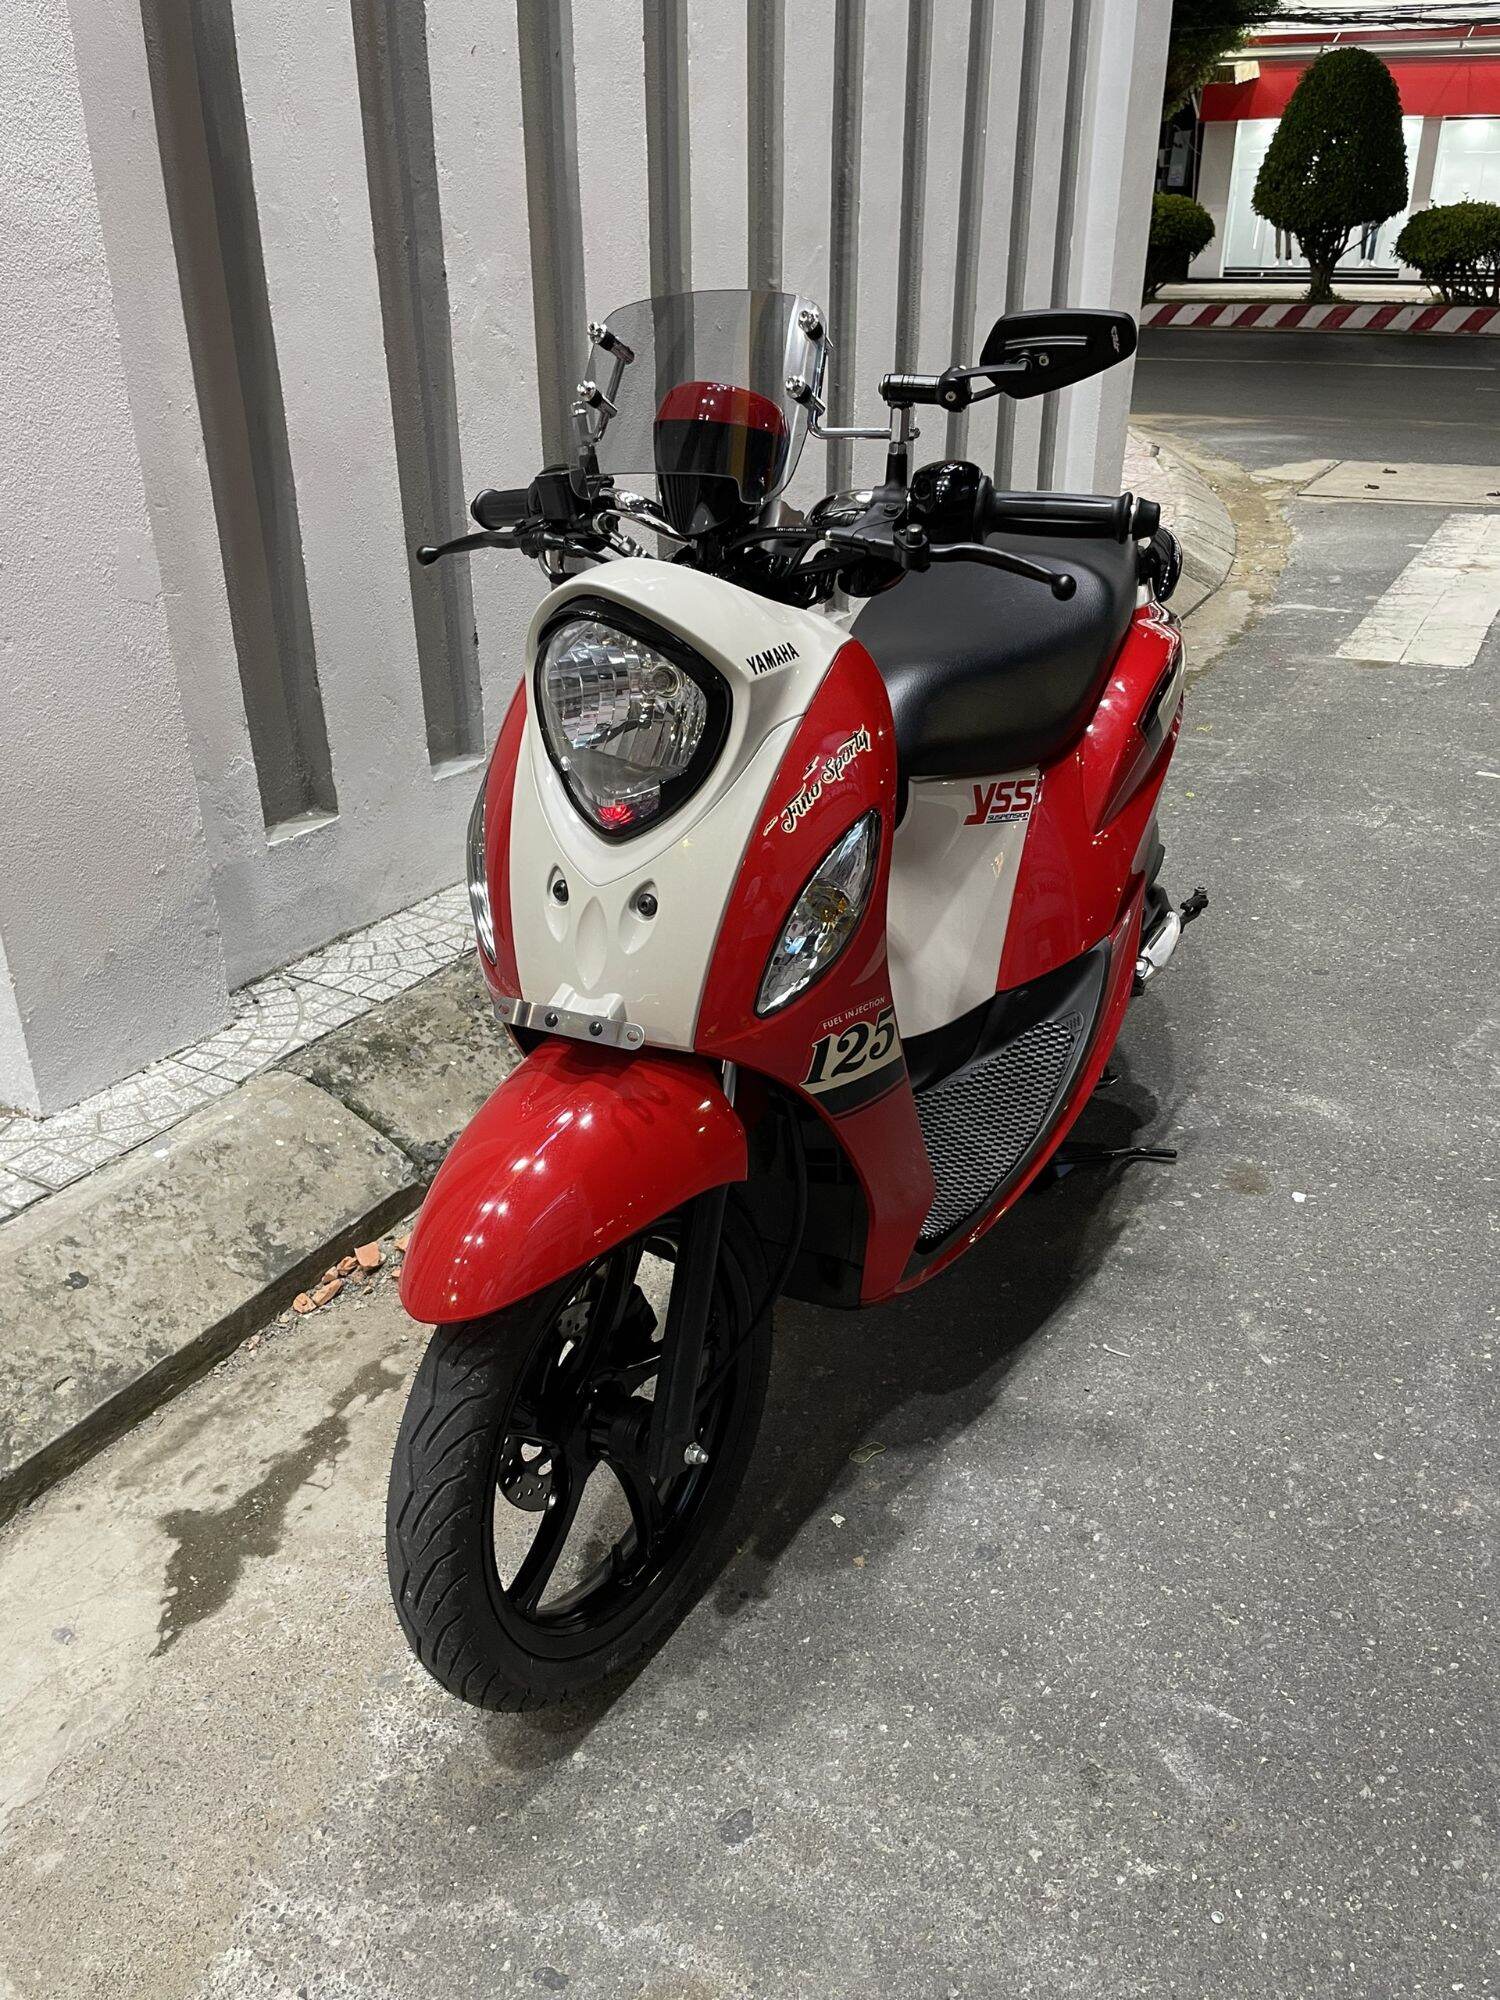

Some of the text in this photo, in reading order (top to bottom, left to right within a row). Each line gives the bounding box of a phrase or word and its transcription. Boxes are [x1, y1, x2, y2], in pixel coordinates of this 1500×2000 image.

[746, 642, 800, 676] YAMAHA
[781, 723, 872, 833] Fino Sporty
[963, 780, 1036, 825] YSS
[822, 996, 886, 1030] FUEL INJECTION
[801, 1004, 896, 1086] 125
